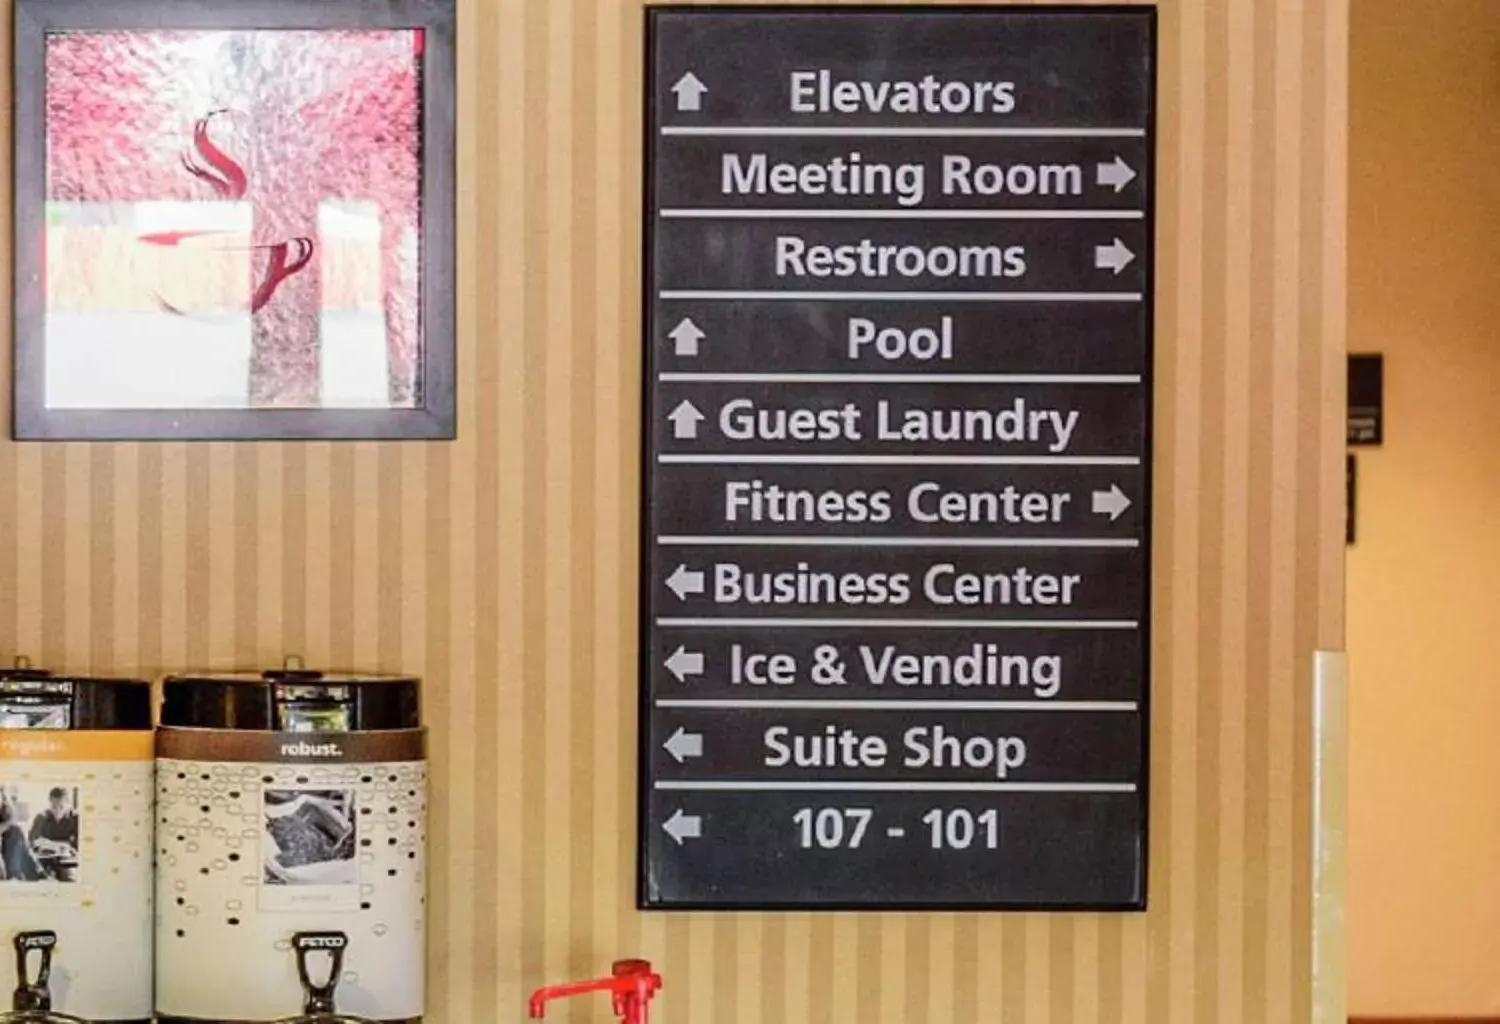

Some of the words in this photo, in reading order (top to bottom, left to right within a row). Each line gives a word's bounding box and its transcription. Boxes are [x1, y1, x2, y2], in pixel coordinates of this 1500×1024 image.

[790, 69, 1016, 113] Elevators
[721, 152, 925, 206] Meeting
[942, 155, 1082, 195] Room
[775, 236, 1027, 277] Restrooms
[848, 316, 953, 359] Pool
[719, 399, 861, 440] Guest
[877, 397, 1079, 452] Laundry
[725, 479, 891, 522] Fitness
[908, 482, 1071, 523] Center
[714, 562, 910, 604] Business
[924, 563, 1080, 605] Center
[731, 644, 797, 685] Ice
[811, 644, 847, 686] &
[859, 643, 1062, 697] Vending
[281, 741, 344, 756] robust.
[764, 725, 888, 767] Suite
[903, 725, 1026, 778] Shop
[793, 808, 873, 849] 107
[887, 828, 905, 837] -
[923, 808, 998, 849] 101
